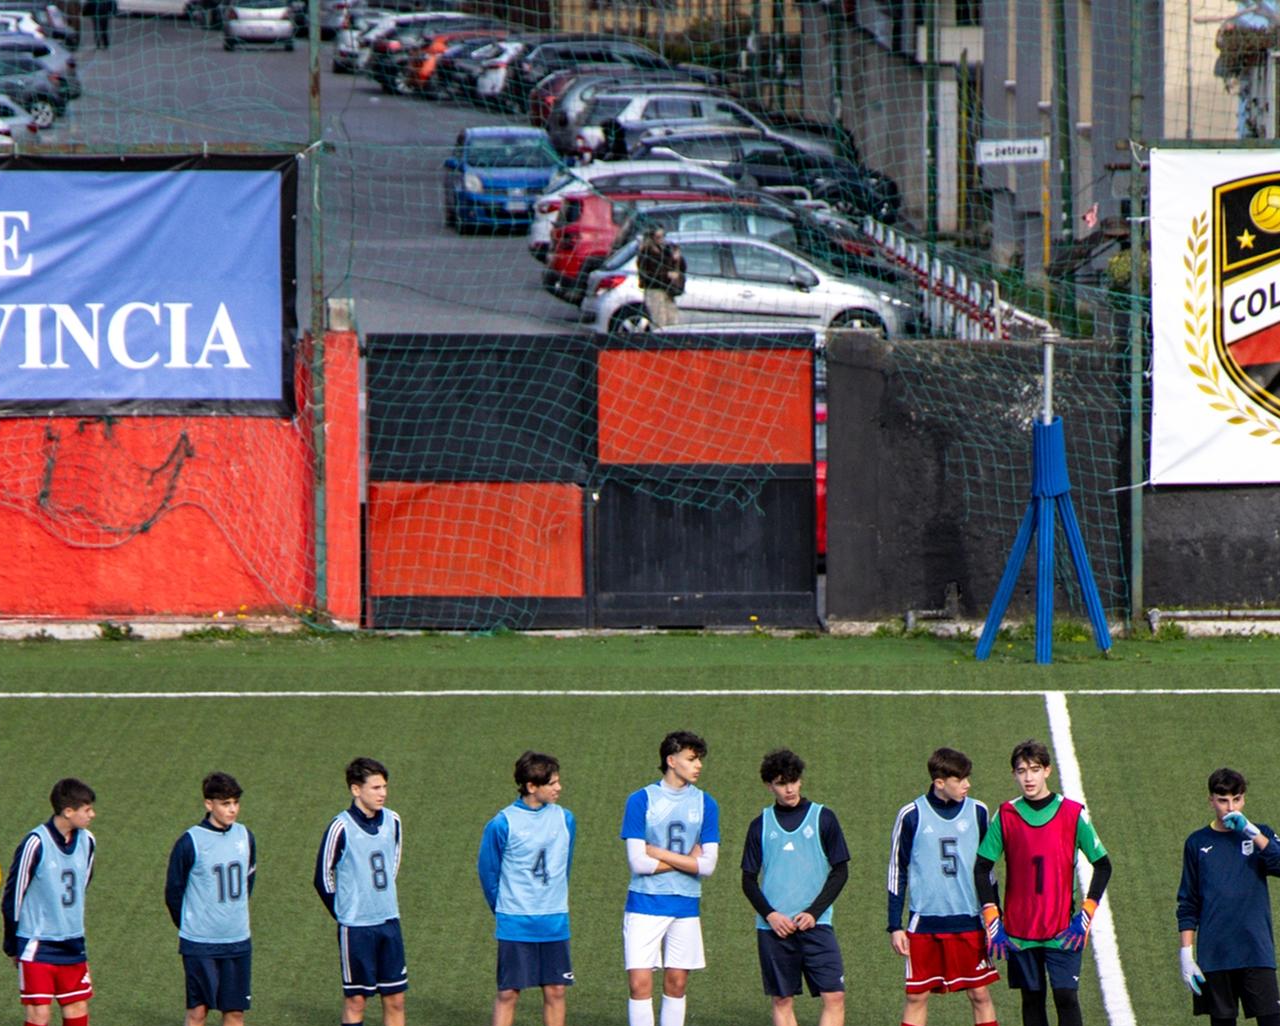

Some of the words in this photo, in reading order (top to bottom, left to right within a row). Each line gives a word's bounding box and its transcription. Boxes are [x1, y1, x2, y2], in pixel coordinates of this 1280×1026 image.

[668, 820, 686, 855] 6
[370, 850, 388, 892] 8
[532, 848, 549, 885] 4
[939, 837, 958, 879] 5
[1032, 855, 1045, 895] 1
[61, 869, 76, 909] 3
[213, 860, 242, 903] 10
